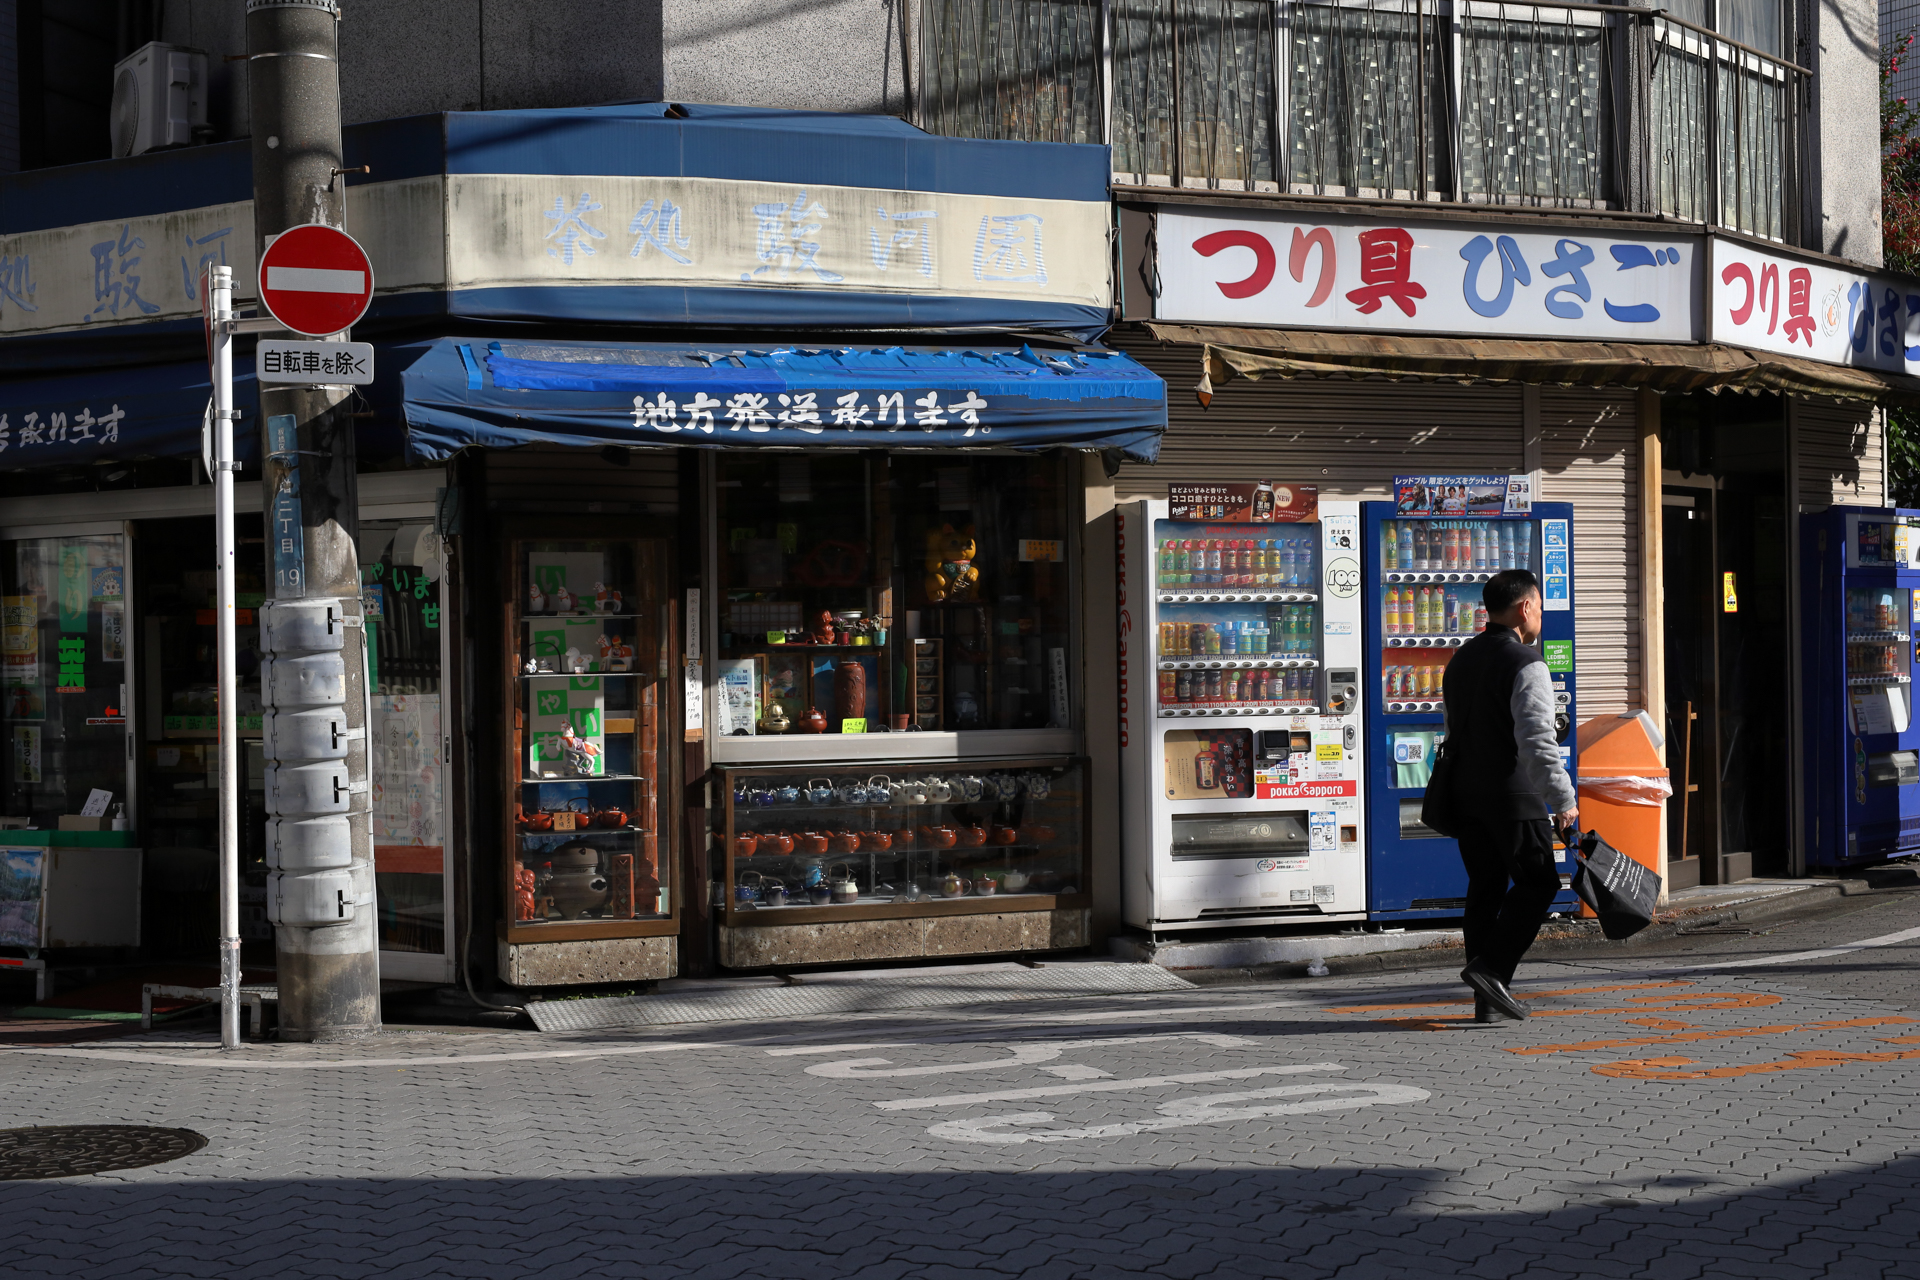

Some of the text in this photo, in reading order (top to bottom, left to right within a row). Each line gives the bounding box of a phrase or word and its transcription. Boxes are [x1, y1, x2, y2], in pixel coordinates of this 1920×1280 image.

[1191, 227, 1680, 323] つり具 ひさご
[1721, 262, 1817, 347] つり具
[264, 349, 366, 375] 自転車を除く
[630, 391, 992, 438] 地方発送承ります。
[1395, 476, 1427, 485] レッドブル
[1431, 521, 1489, 530] SUNTORY
[278, 568, 300, 587] 19
[1328, 569, 1360, 587] 100
[1223, 744, 1235, 791] 深い味わい
[1236, 737, 1247, 778] 香り高く
